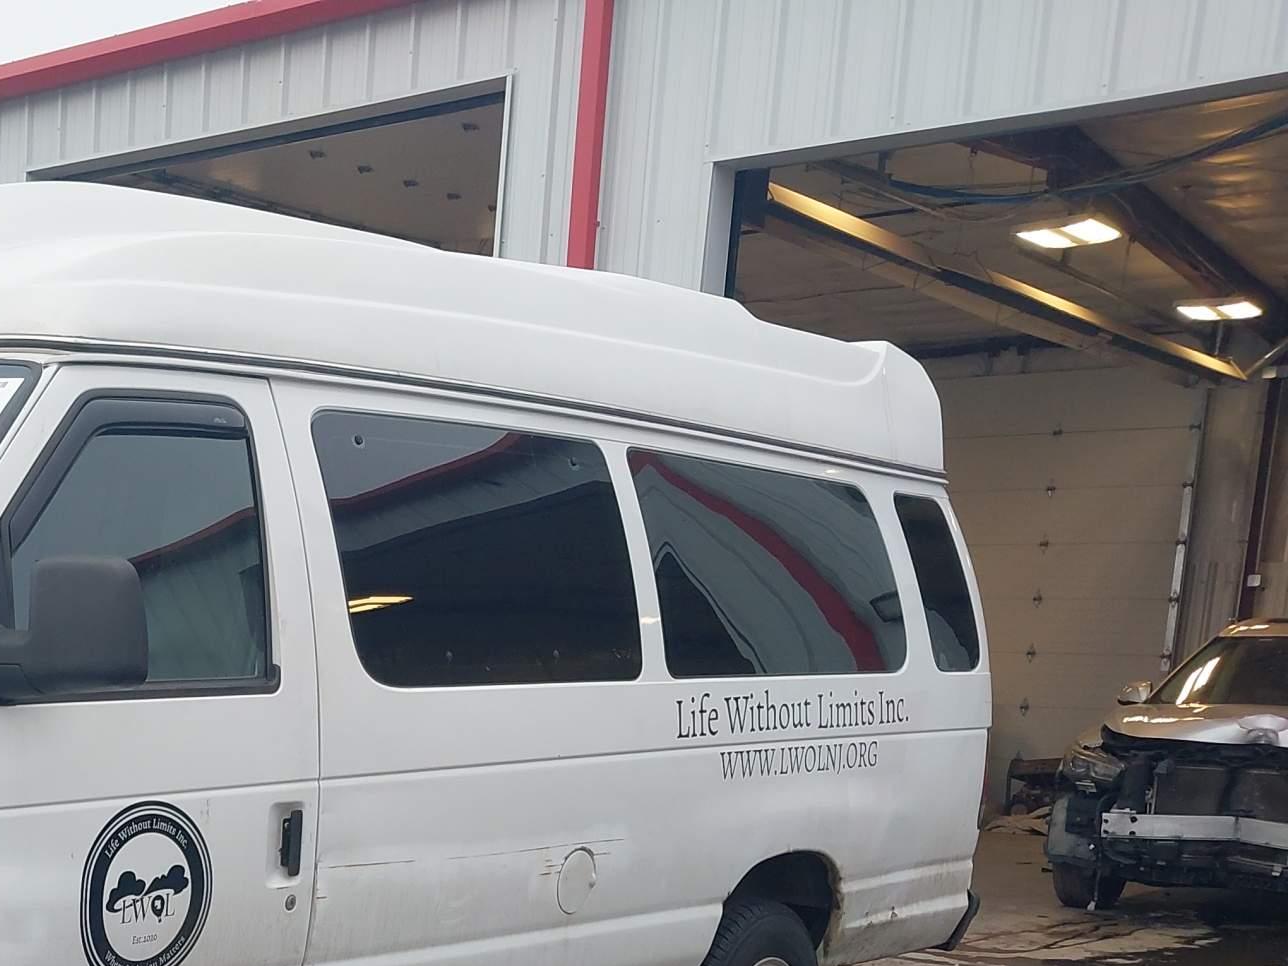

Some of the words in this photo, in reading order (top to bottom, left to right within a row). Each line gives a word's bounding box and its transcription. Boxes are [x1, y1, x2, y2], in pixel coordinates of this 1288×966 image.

[676, 693, 718, 738] Life
[724, 689, 811, 734] Without
[817, 689, 875, 729] Limits
[878, 691, 910, 725] Inc.
[720, 741, 878, 781] WWW.LWOLNJ.ORG
[105, 840, 120, 858] Life
[118, 819, 151, 842] Without
[152, 818, 176, 835] Limits
[175, 832, 189, 849] Inc.
[159, 937, 185, 965] Matters
